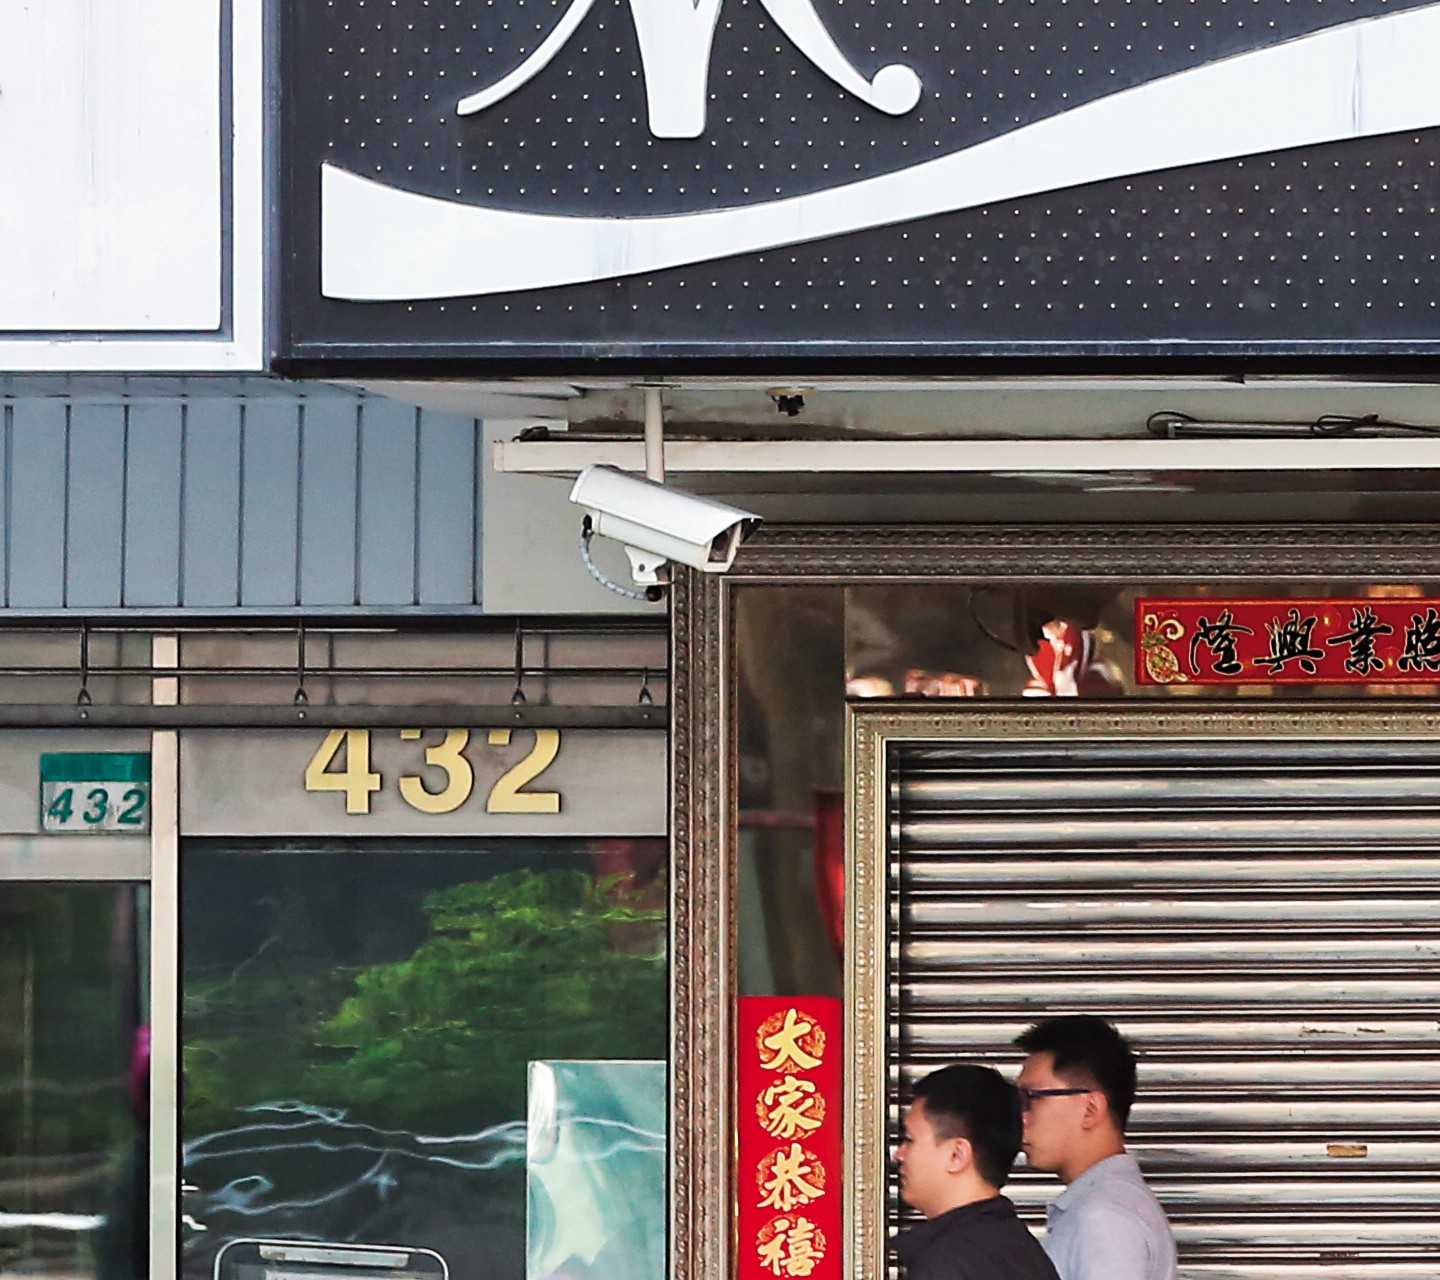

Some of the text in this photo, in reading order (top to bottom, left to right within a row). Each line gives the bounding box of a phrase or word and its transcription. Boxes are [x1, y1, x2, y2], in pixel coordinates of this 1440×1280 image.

[48, 788, 145, 824] 432
[304, 729, 561, 814] 432
[757, 1008, 825, 1277] 大家恭禧
